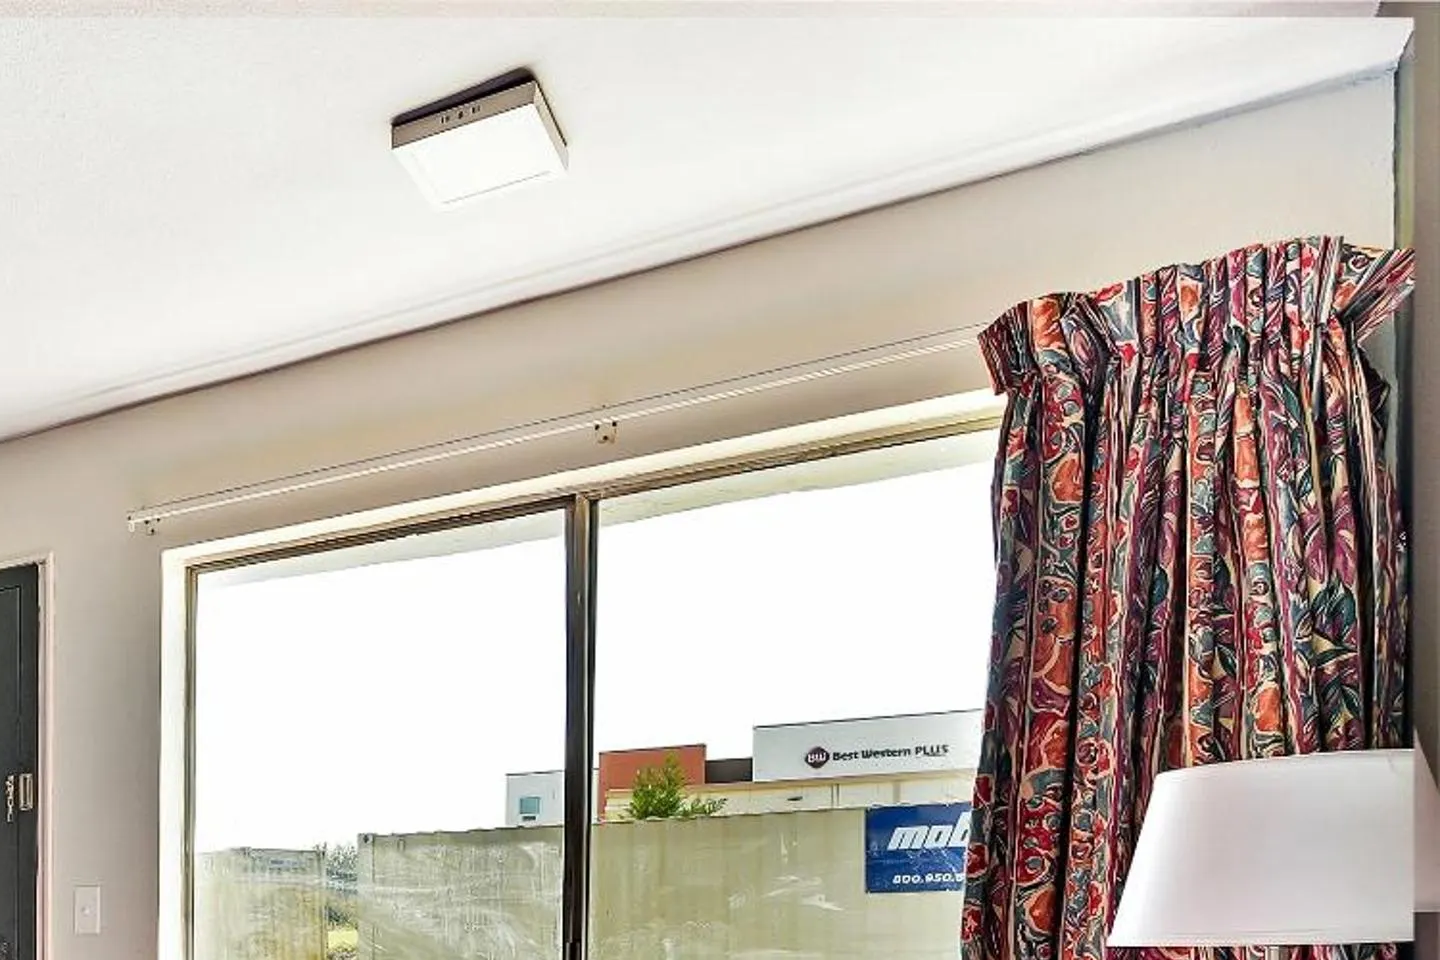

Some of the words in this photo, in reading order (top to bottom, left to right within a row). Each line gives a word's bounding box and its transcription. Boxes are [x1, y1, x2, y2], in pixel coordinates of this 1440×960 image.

[832, 751, 859, 761] Best
[861, 748, 911, 759] Western
[915, 744, 950, 756] PLUS
